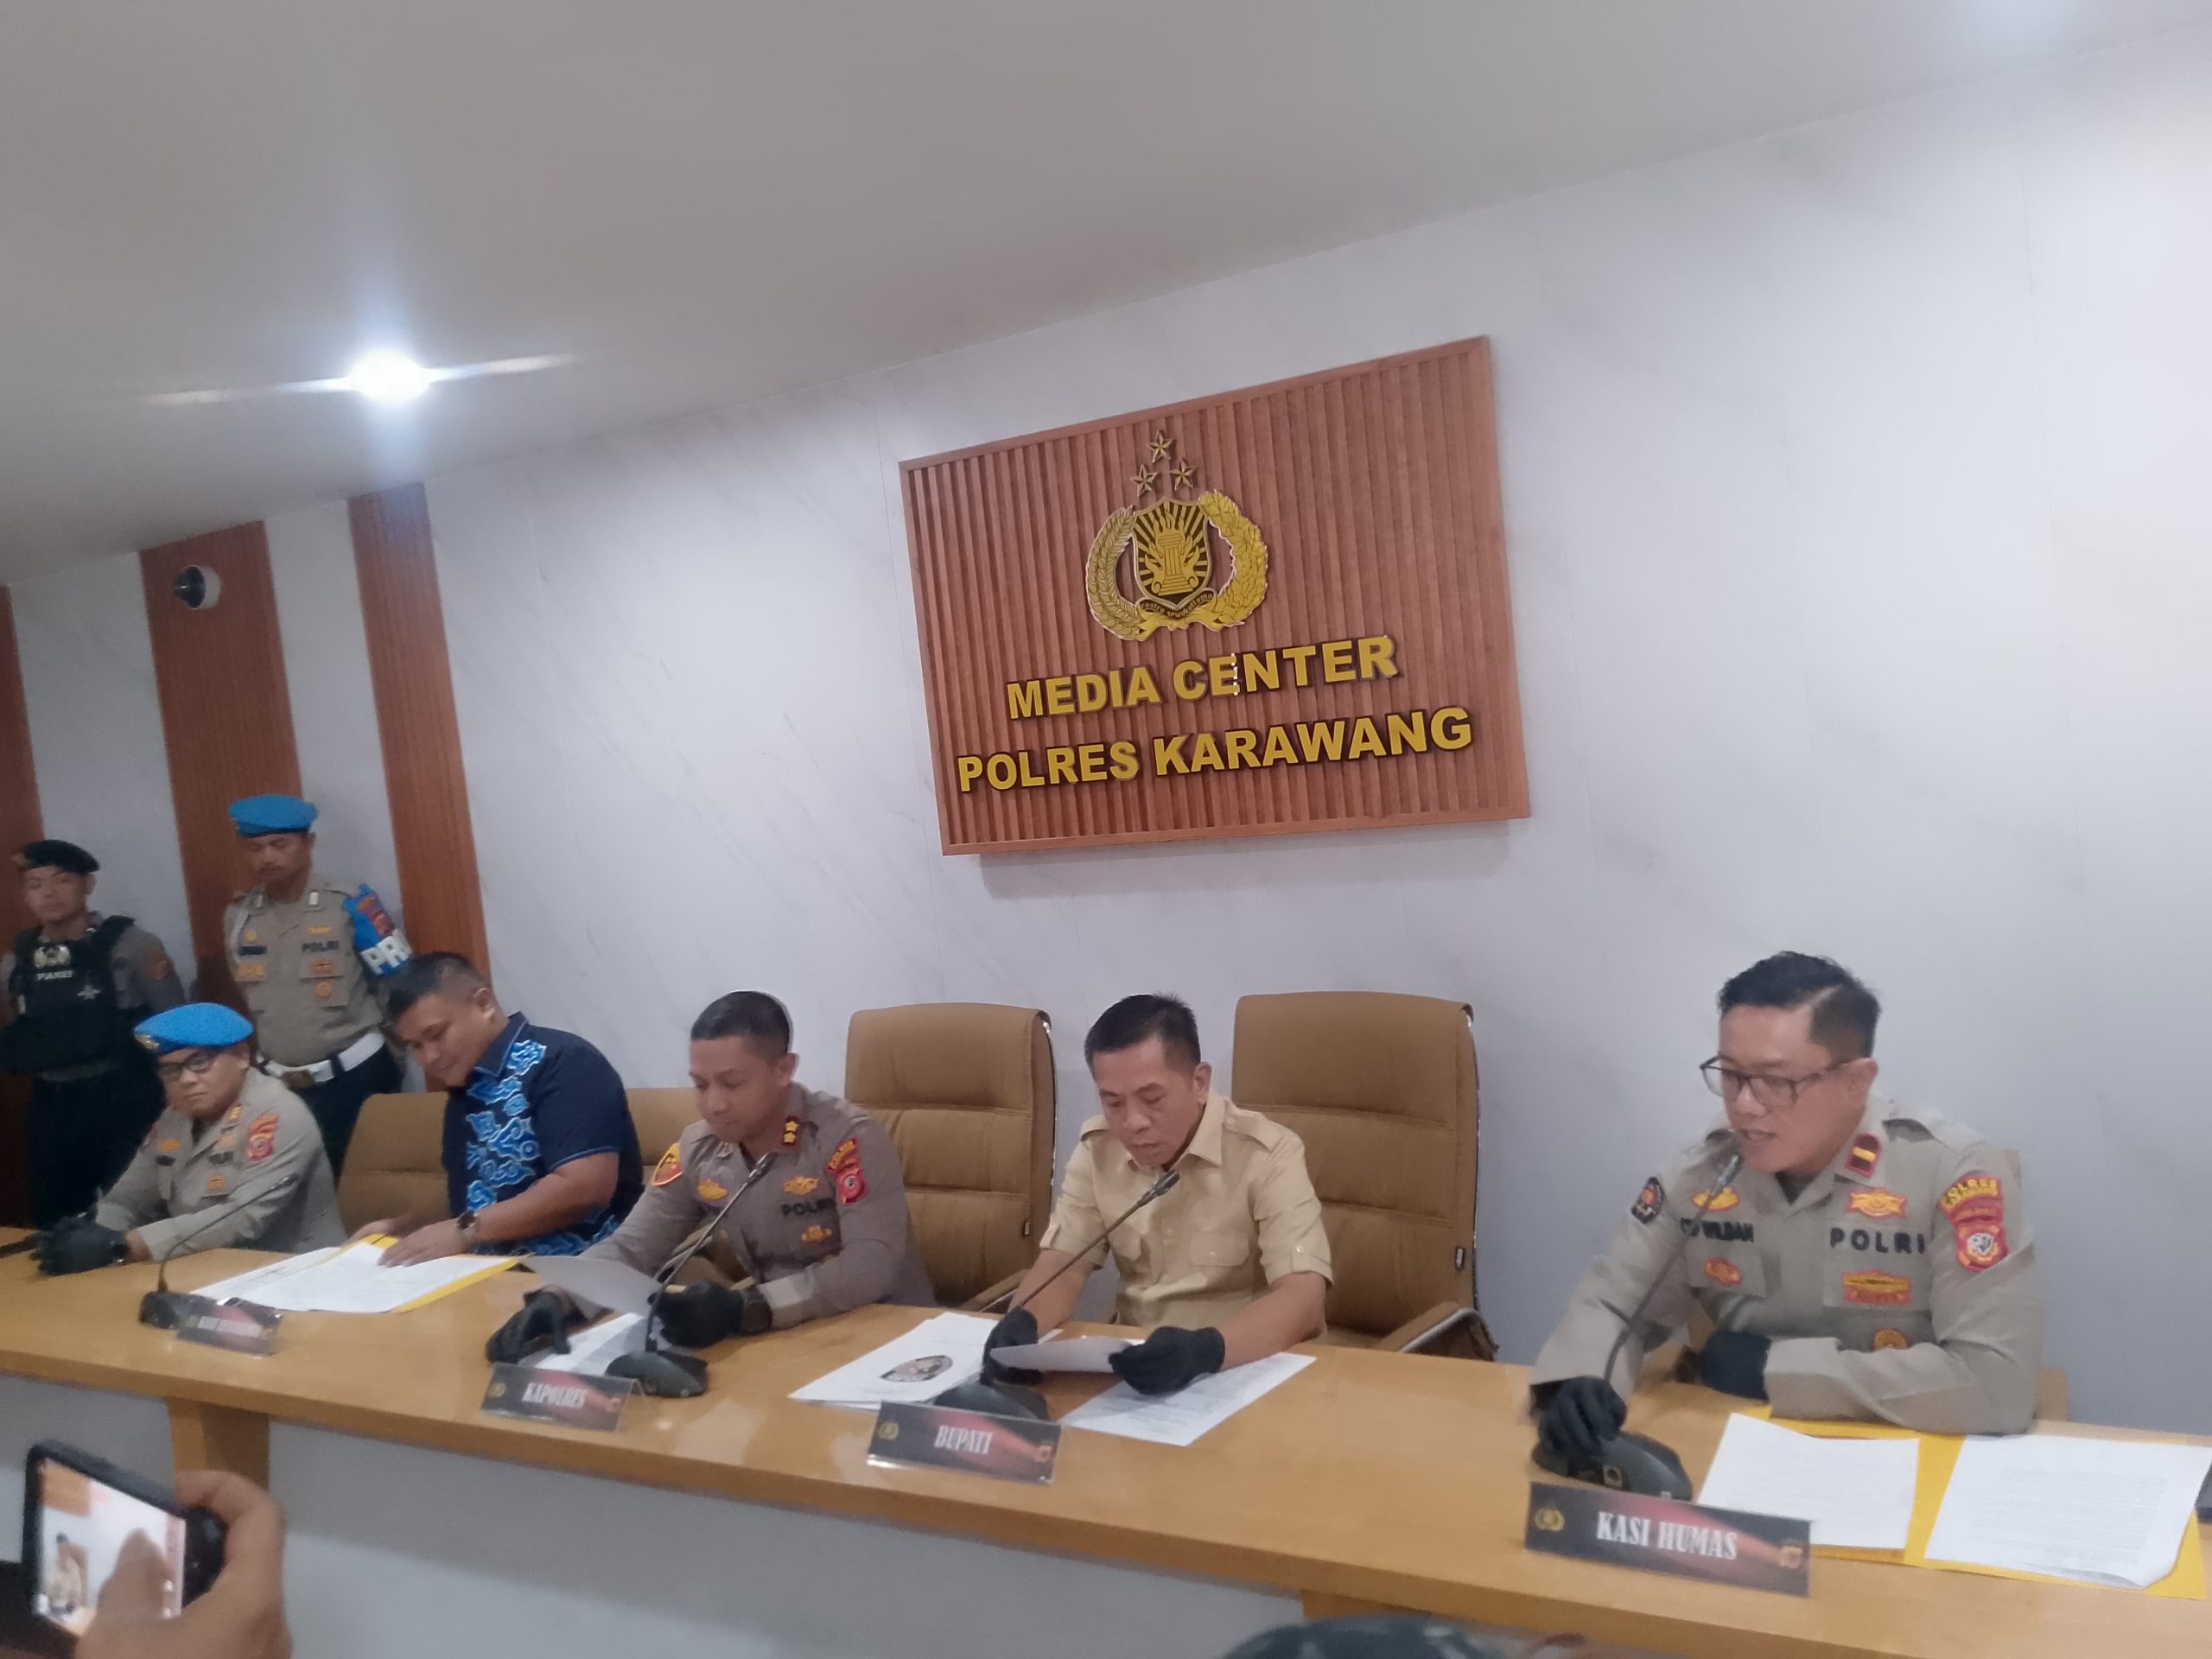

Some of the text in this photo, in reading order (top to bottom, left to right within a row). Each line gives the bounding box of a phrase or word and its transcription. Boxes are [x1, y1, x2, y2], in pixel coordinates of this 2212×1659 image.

[1007, 635, 1398, 719] MEDIA CENTER
[957, 707, 1471, 791] POLRES KARAWANG
[781, 1198, 836, 1217] POLRI
[1829, 1227, 1926, 1254] POLRI
[522, 1382, 588, 1409] KAPOLRES
[933, 1425, 994, 1455] BUPATI
[1596, 1511, 1738, 1560] KASI HUMAS
